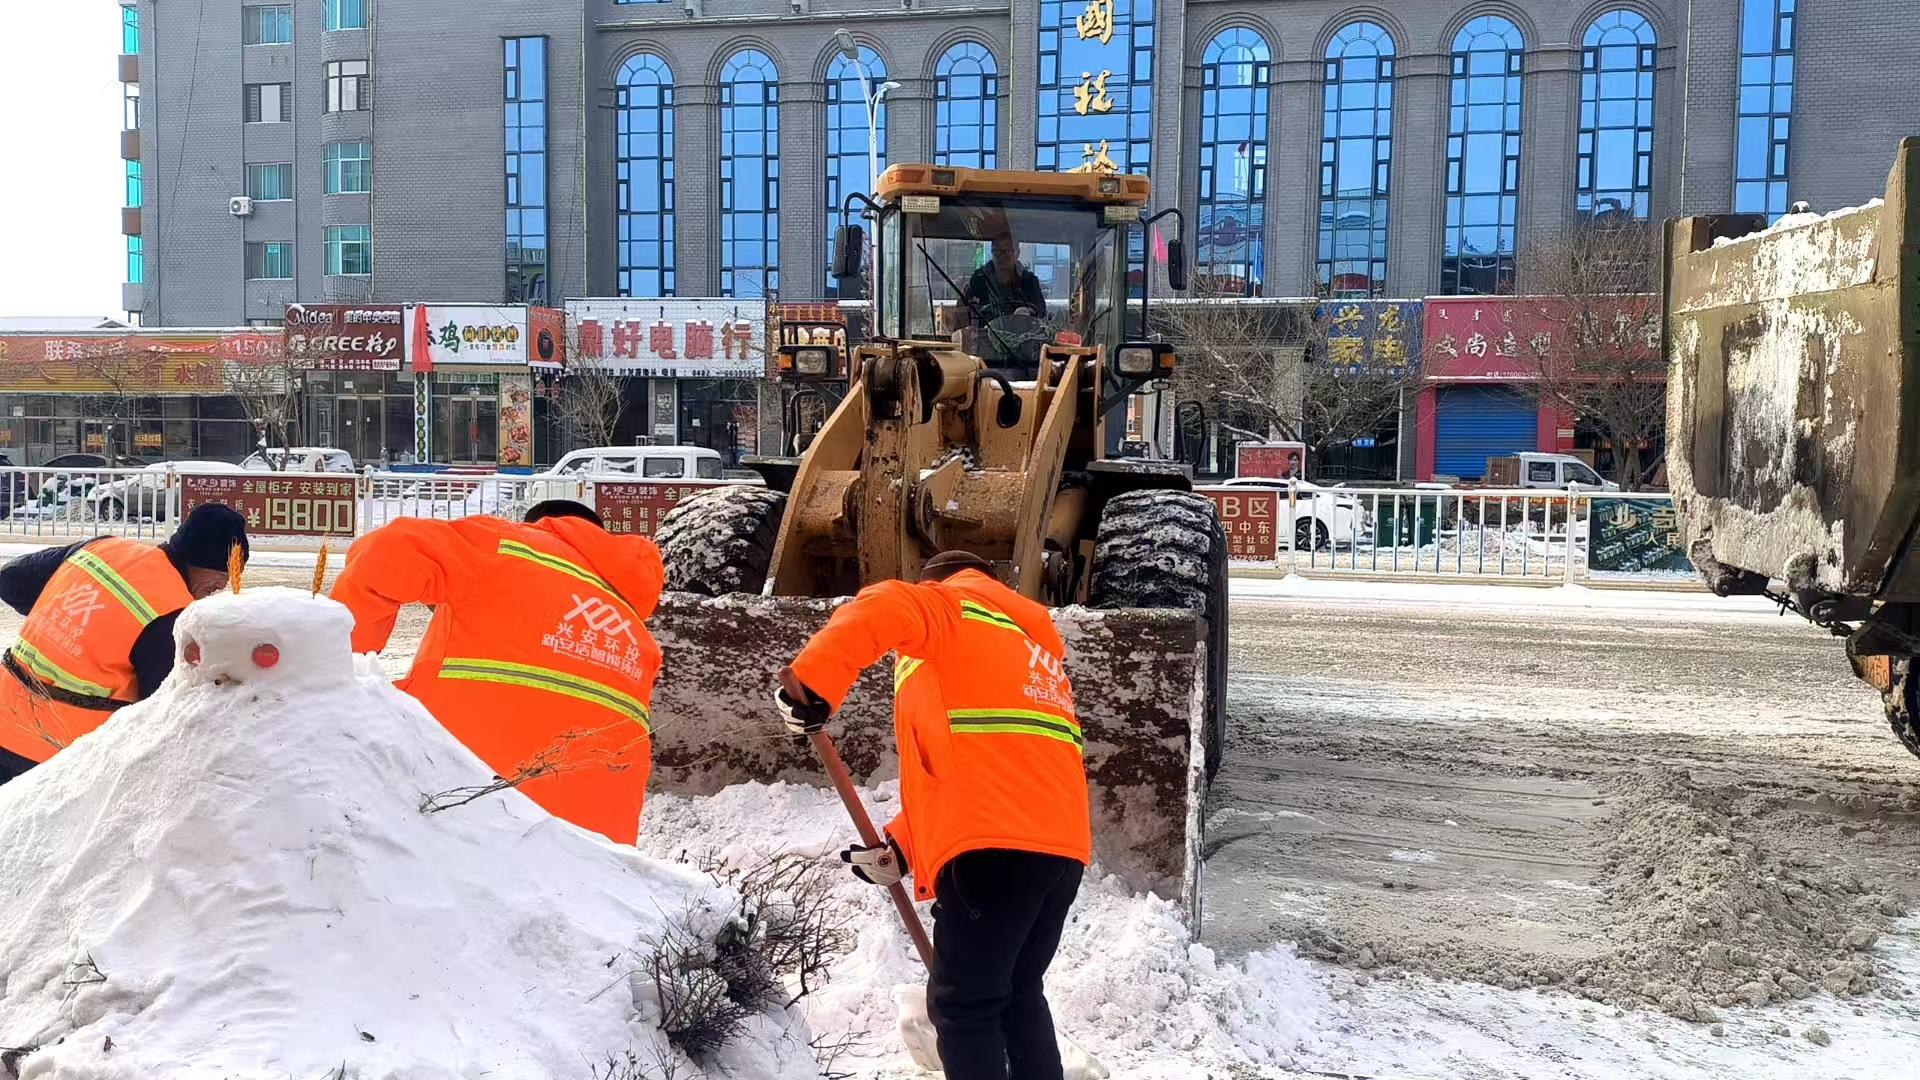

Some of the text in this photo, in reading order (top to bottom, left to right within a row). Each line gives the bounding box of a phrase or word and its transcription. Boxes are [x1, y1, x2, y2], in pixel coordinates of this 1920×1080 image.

[286, 304, 400, 325] Midea 美的中央空调
[309, 335, 365, 352] GREE
[577, 317, 752, 360] 鼎好电脑行
[242, 480, 293, 494] 全屋柜子
[300, 482, 352, 496] 安装到家
[1227, 535, 1269, 544] 型社区
[556, 621, 641, 664] 兴安环投
